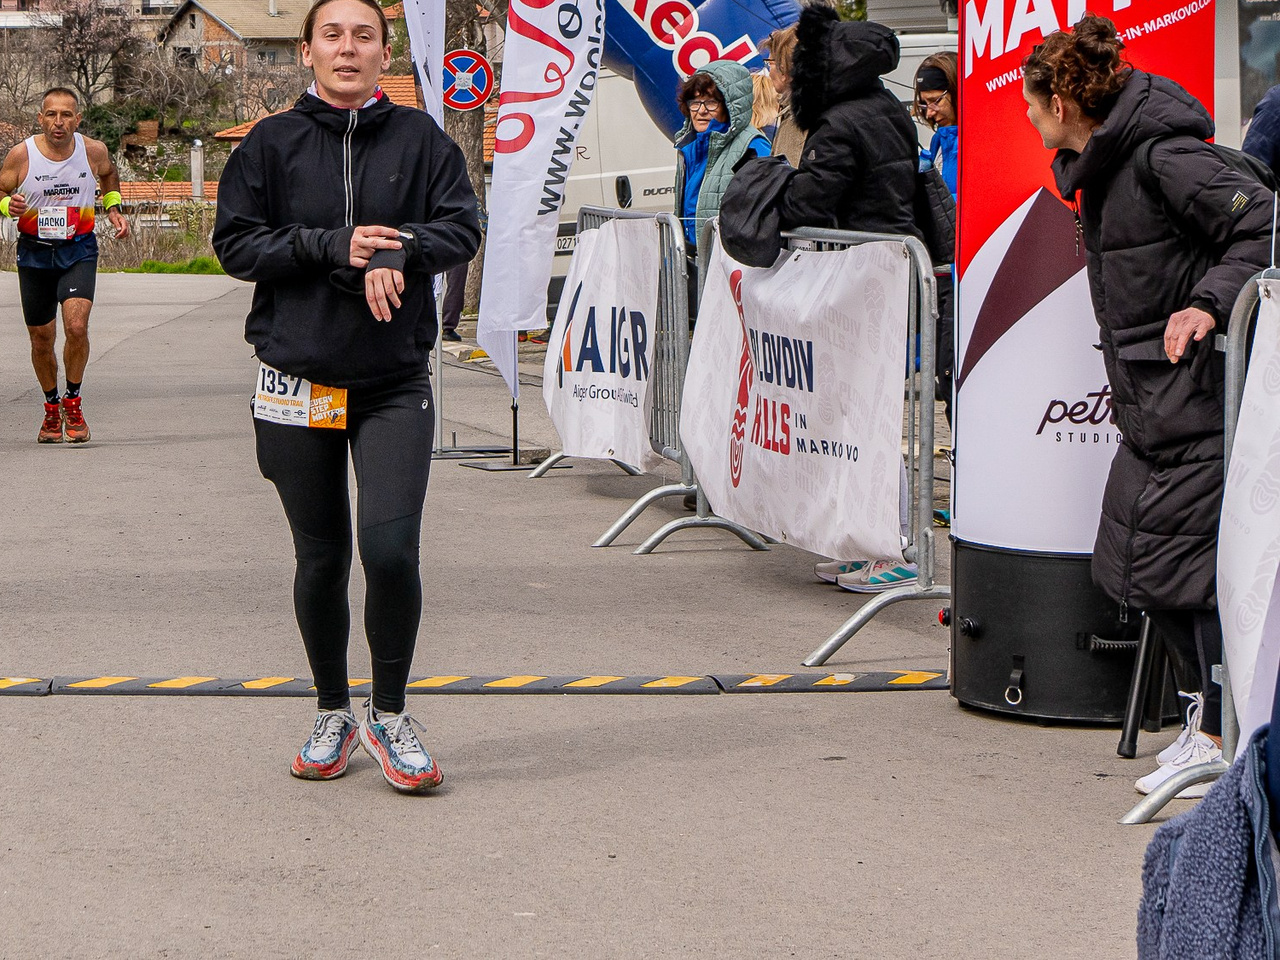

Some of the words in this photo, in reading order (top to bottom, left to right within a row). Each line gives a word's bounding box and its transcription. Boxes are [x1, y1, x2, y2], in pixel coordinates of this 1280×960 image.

[43, 186, 80, 197] MARATHON
[748, 327, 814, 393] PLOVDIV
[261, 367, 303, 397] 1357
[794, 412, 807, 430] IN
[1055, 431, 1123, 444] STUDIO
[796, 437, 859, 463] MARKOVO
